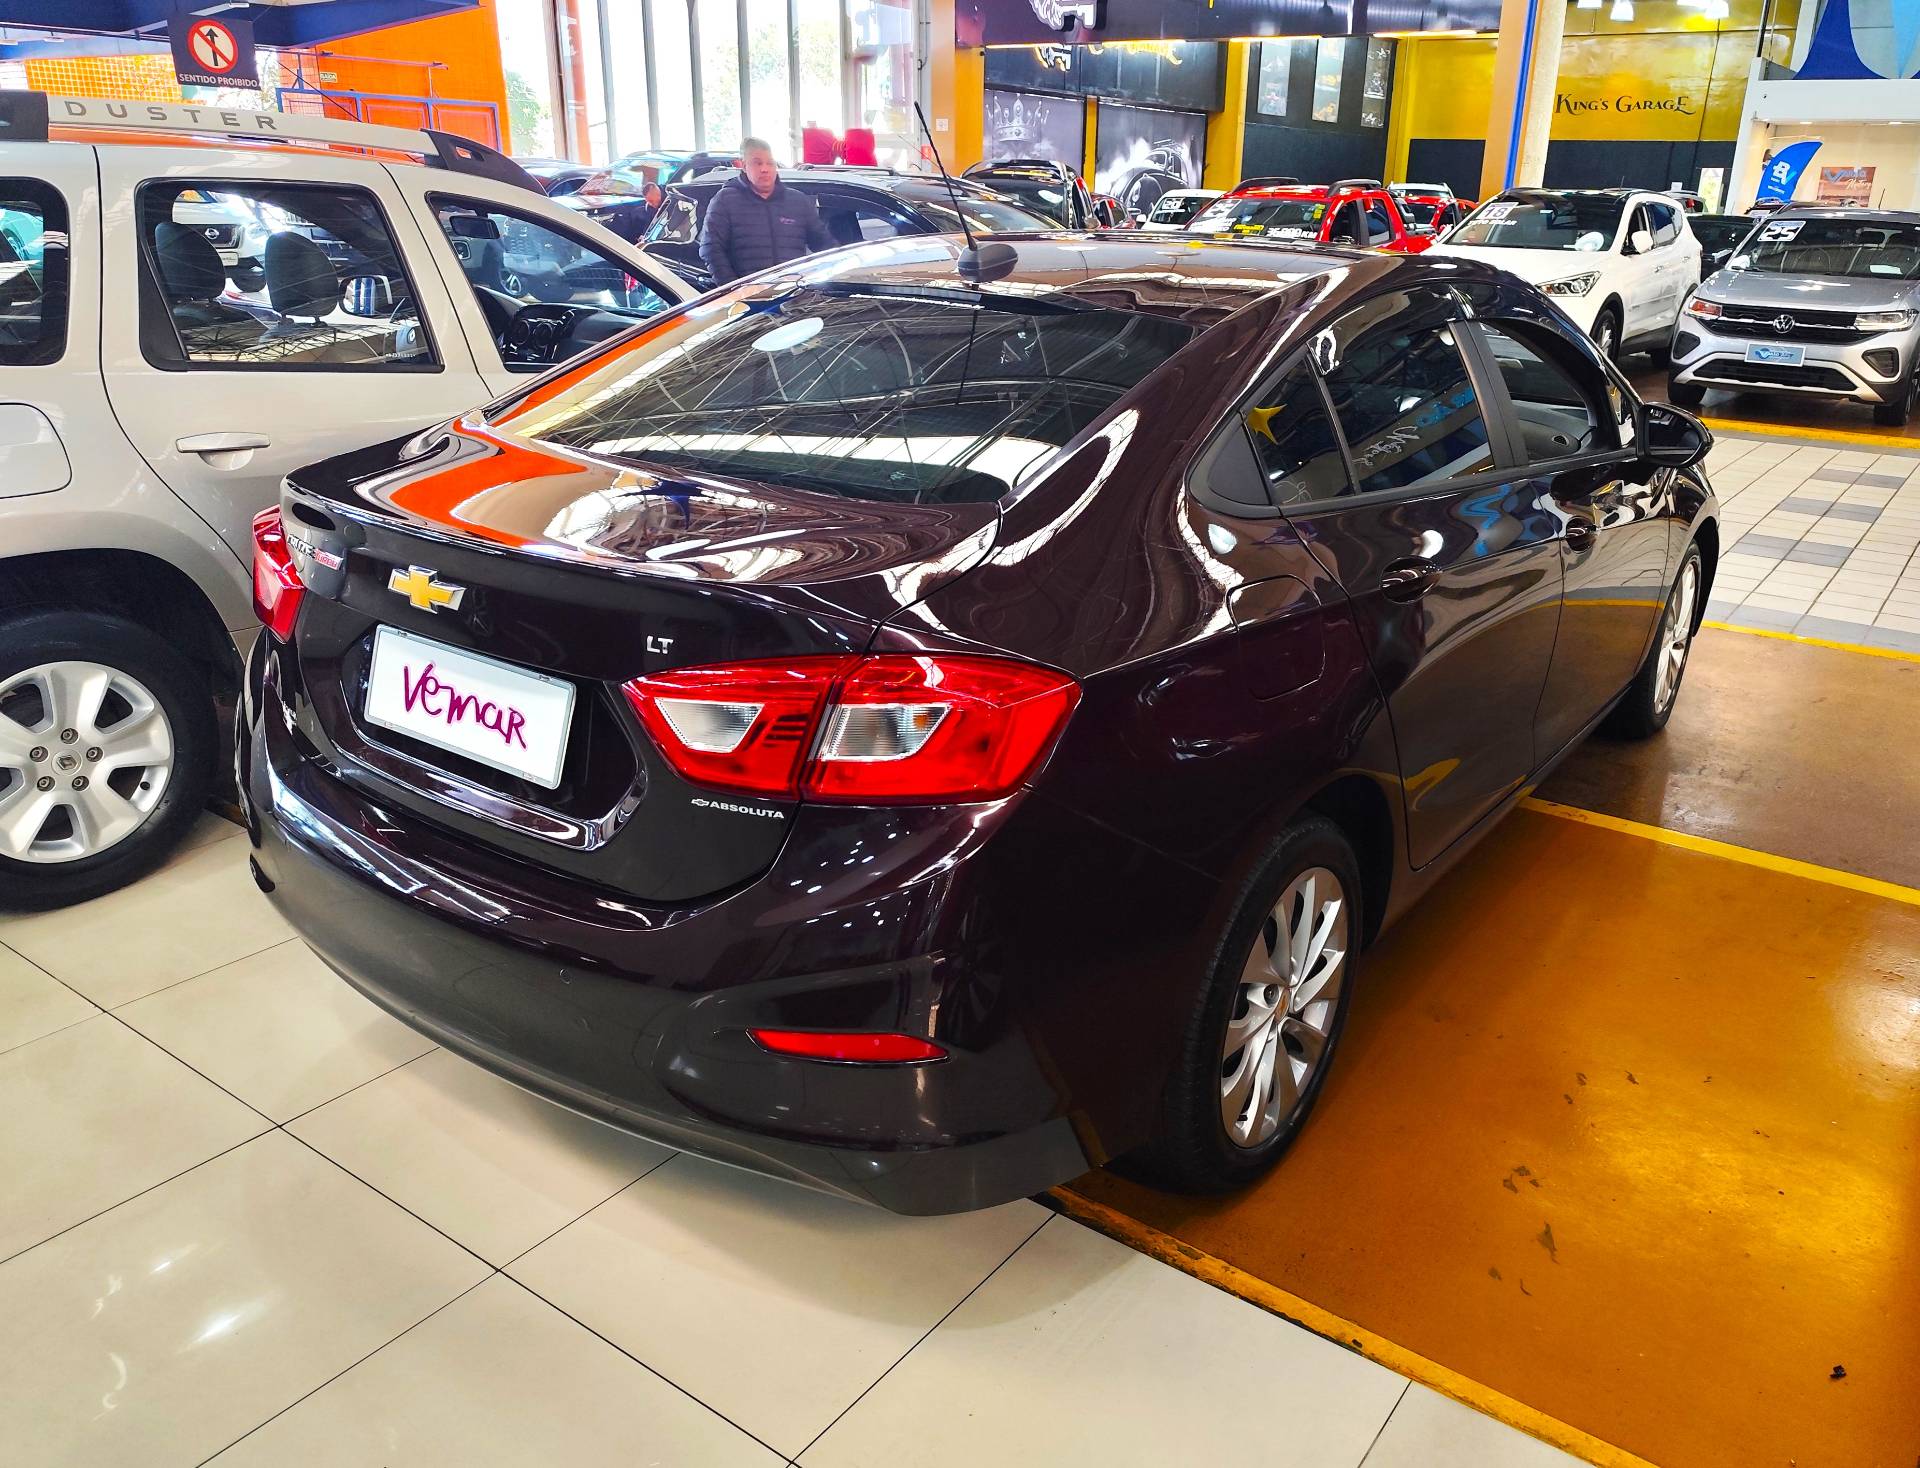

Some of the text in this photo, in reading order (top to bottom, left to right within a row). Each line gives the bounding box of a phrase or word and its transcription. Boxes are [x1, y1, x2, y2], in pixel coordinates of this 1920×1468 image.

[179, 73, 258, 87] SENTIDO PROIBIDO
[1554, 93, 1697, 116] KING'S GARAGE
[64, 100, 277, 131] DUSTER
[1484, 207, 1508, 218] 18
[1760, 225, 1799, 240] 25
[646, 635, 674, 655] LT
[708, 800, 785, 819] ABSOLUTA
